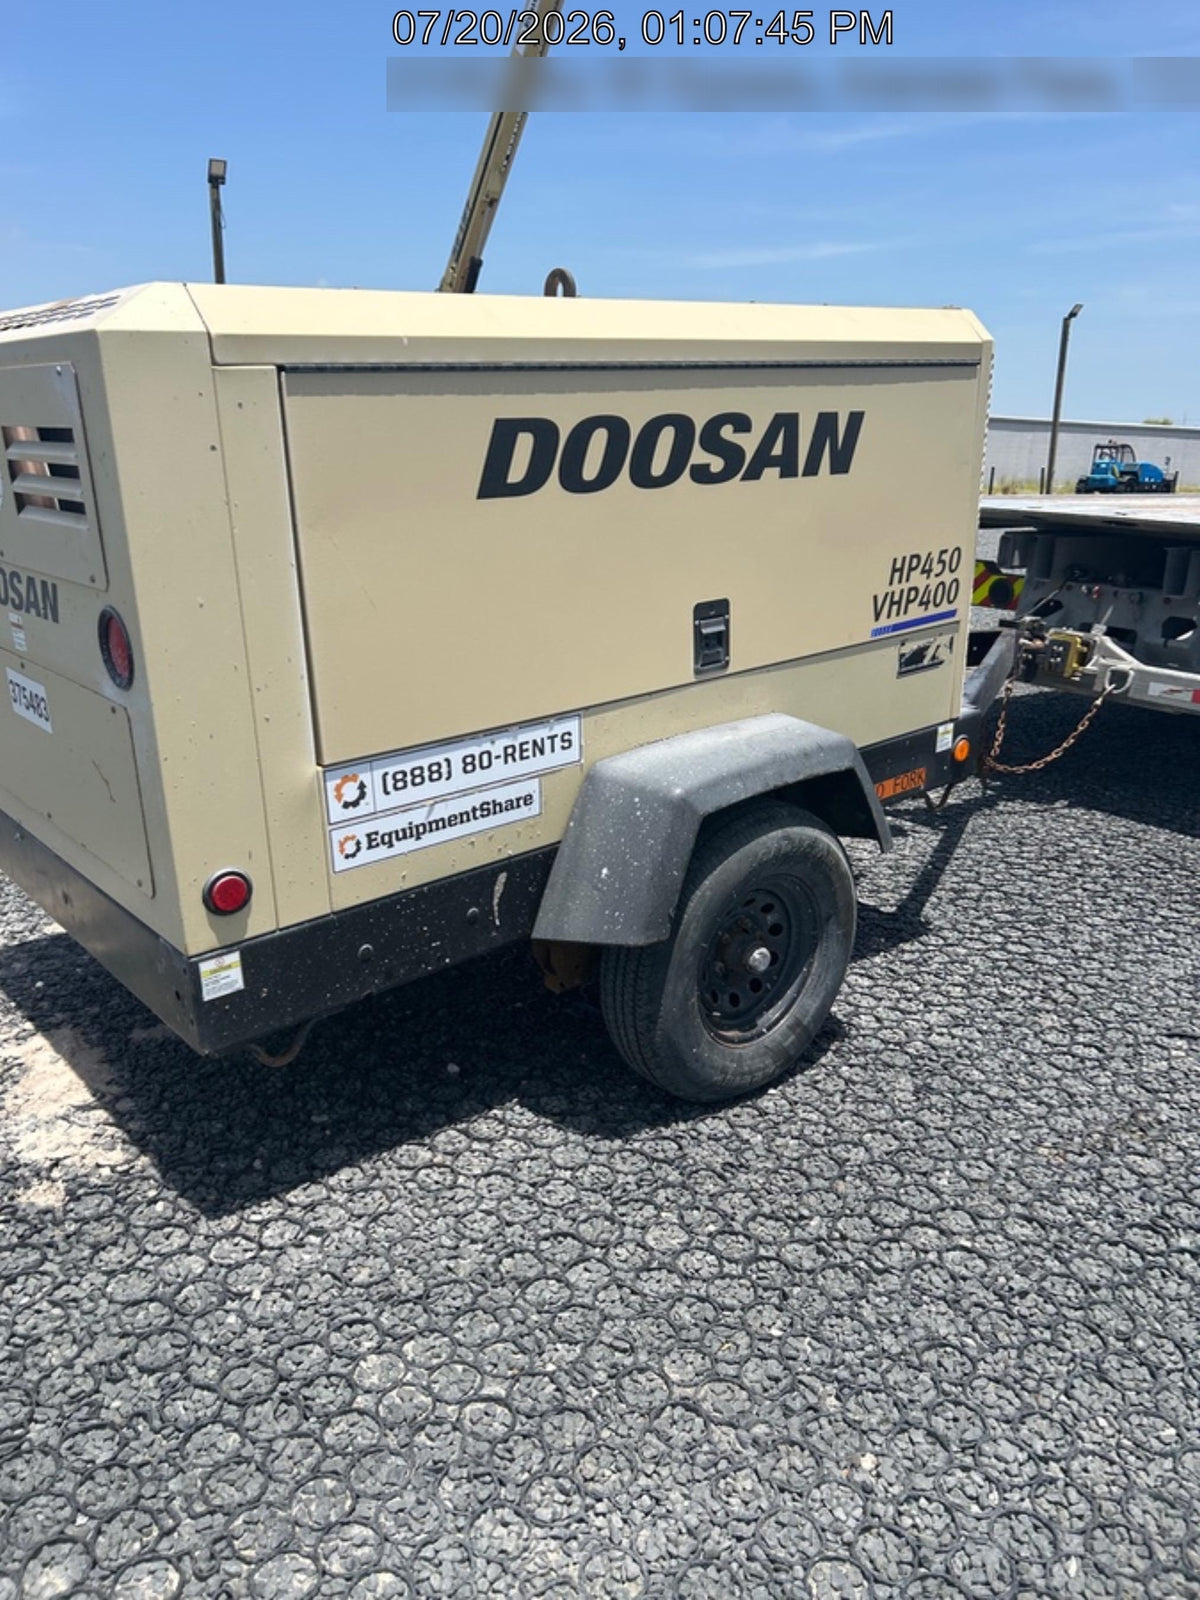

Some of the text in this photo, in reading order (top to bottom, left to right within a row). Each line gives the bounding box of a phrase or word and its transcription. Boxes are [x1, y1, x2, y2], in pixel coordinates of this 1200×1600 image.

[476, 411, 865, 499] DOOSAN
[889, 547, 961, 586] HP450
[872, 578, 960, 622] VHP400
[381, 731, 573, 796] (888) 80-RENTS
[893, 768, 925, 794] FORK
[365, 792, 534, 851] EquipmentShare
